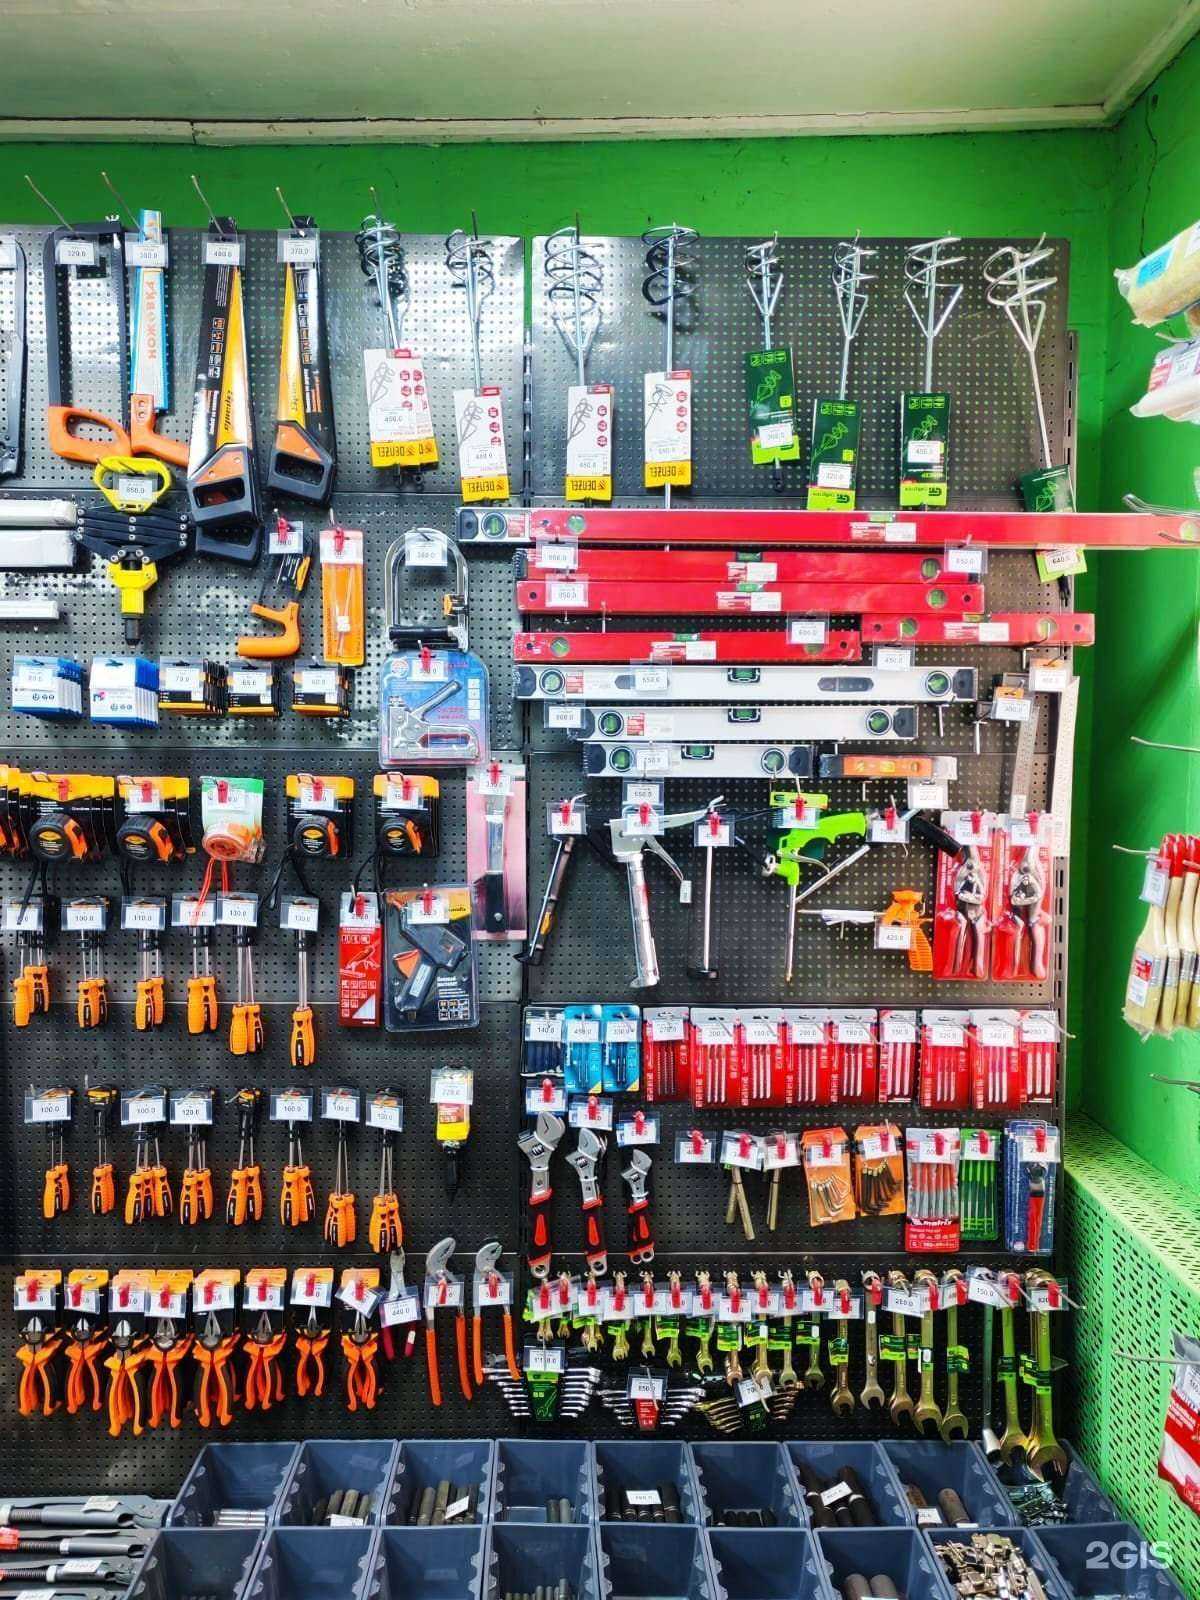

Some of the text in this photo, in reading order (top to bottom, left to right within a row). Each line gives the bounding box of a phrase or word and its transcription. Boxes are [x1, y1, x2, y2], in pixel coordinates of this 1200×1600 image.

[376, 444, 407, 458] DENZEL
[649, 463, 678, 478] DENZEL
[465, 480, 496, 494] DENZEL
[571, 480, 598, 492] DENZEL
